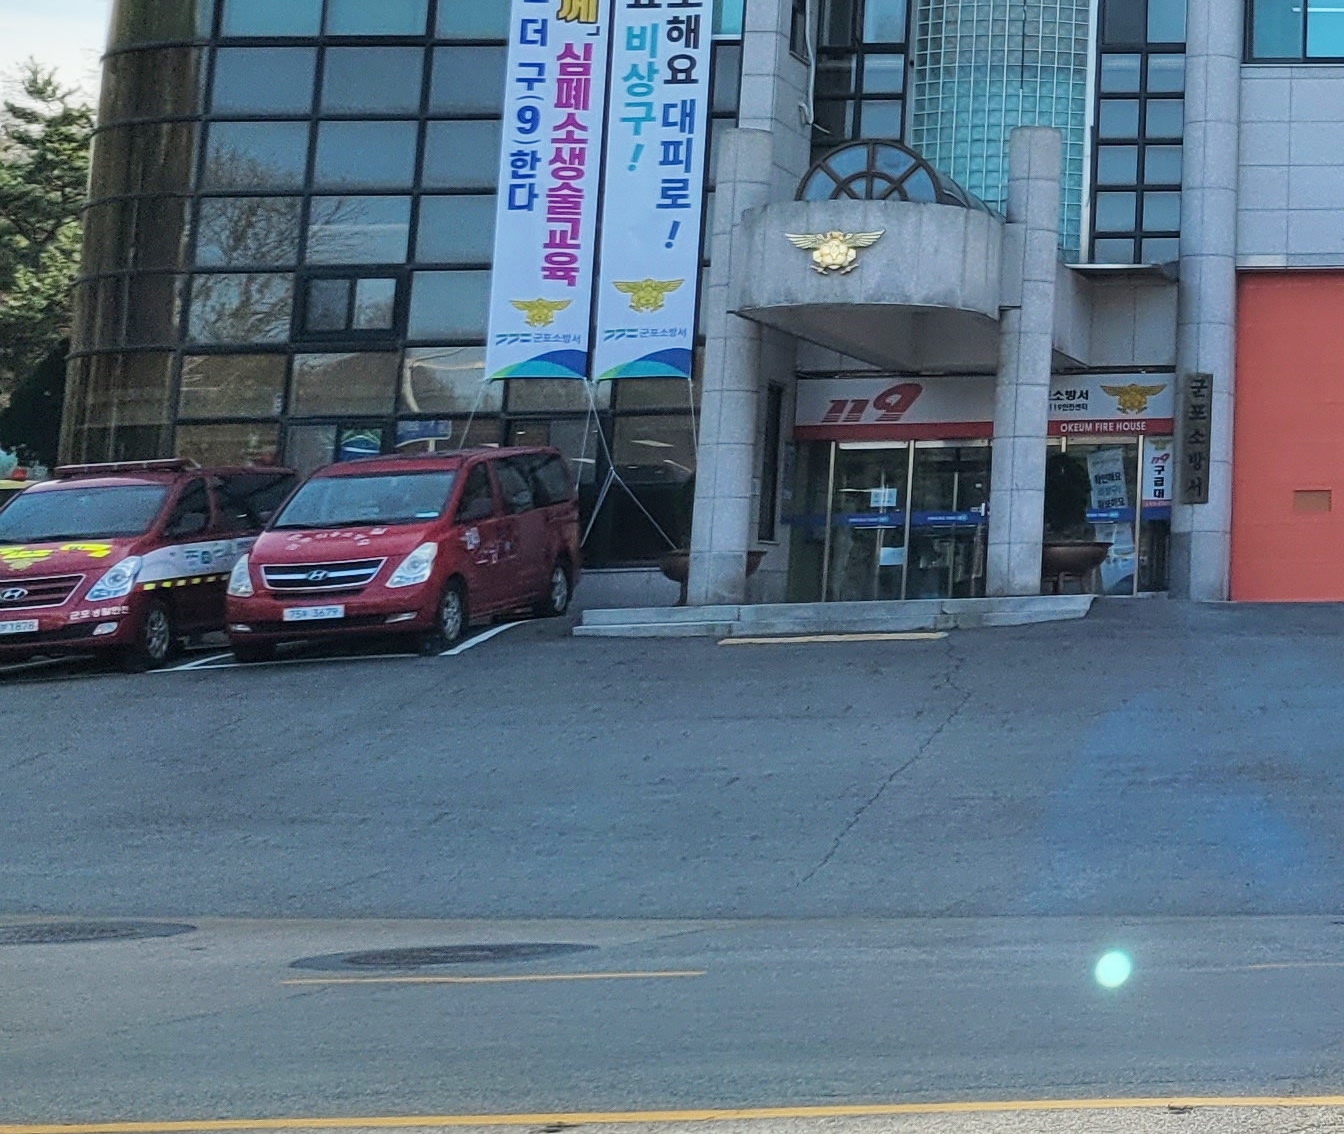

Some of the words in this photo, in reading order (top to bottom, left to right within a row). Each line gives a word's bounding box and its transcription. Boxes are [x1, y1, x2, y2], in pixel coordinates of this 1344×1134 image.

[519, 19, 548, 47] 더
[619, 23, 660, 172] 비상구!
[541, 43, 594, 287] 심폐소생술교육
[656, 98, 697, 249] 대피로!
[533, 332, 581, 345] 군포소방서
[639, 327, 688, 340] 군포소방서
[820, 382, 924, 423] 119
[1049, 389, 1089, 401] 소방서
[1060, 423, 1093, 433] OKEUM
[1095, 422, 1114, 432] FIRE
[1116, 421, 1147, 431] HOUSE
[1187, 378, 1209, 499] 군포소방서
[1153, 465, 1166, 500] 구급대
